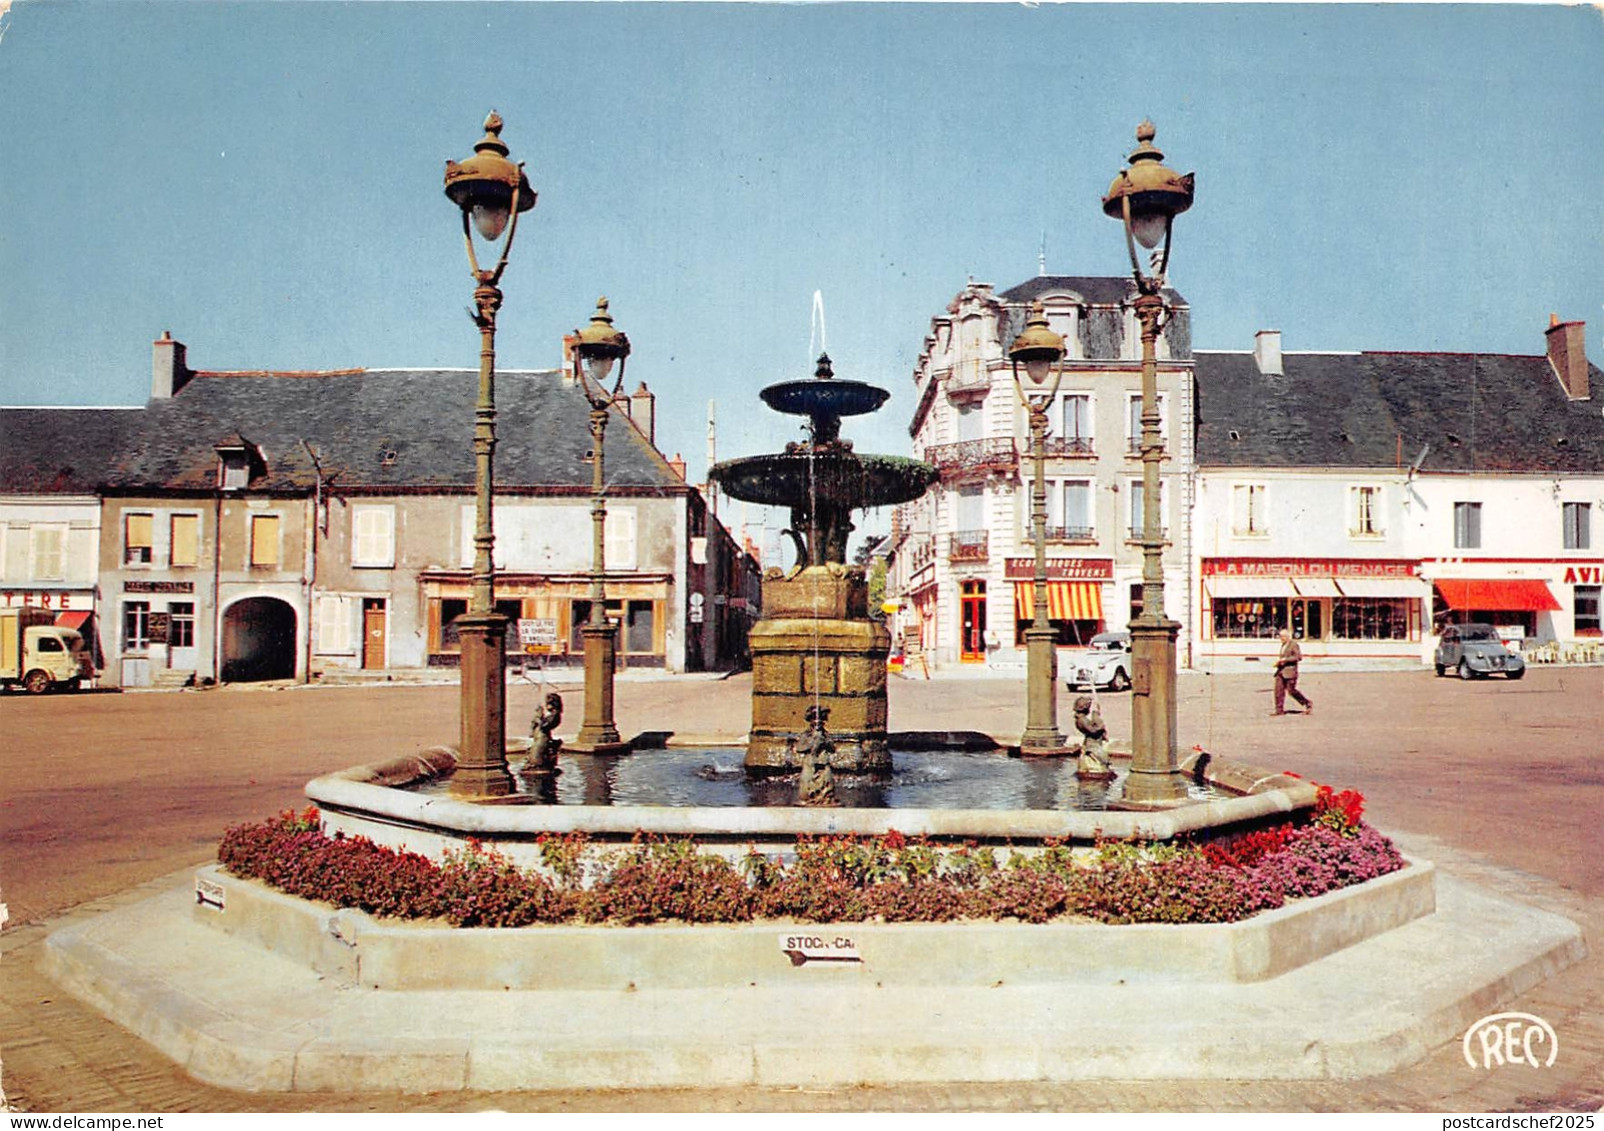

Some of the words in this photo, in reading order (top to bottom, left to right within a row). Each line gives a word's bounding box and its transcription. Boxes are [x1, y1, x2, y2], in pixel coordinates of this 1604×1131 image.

[1215, 563, 1237, 575] LA
[1242, 563, 1304, 575] MAISON
[1309, 564, 1332, 576] DU
[1338, 564, 1406, 577] MENAGE
[1563, 567, 1604, 584] AVI
